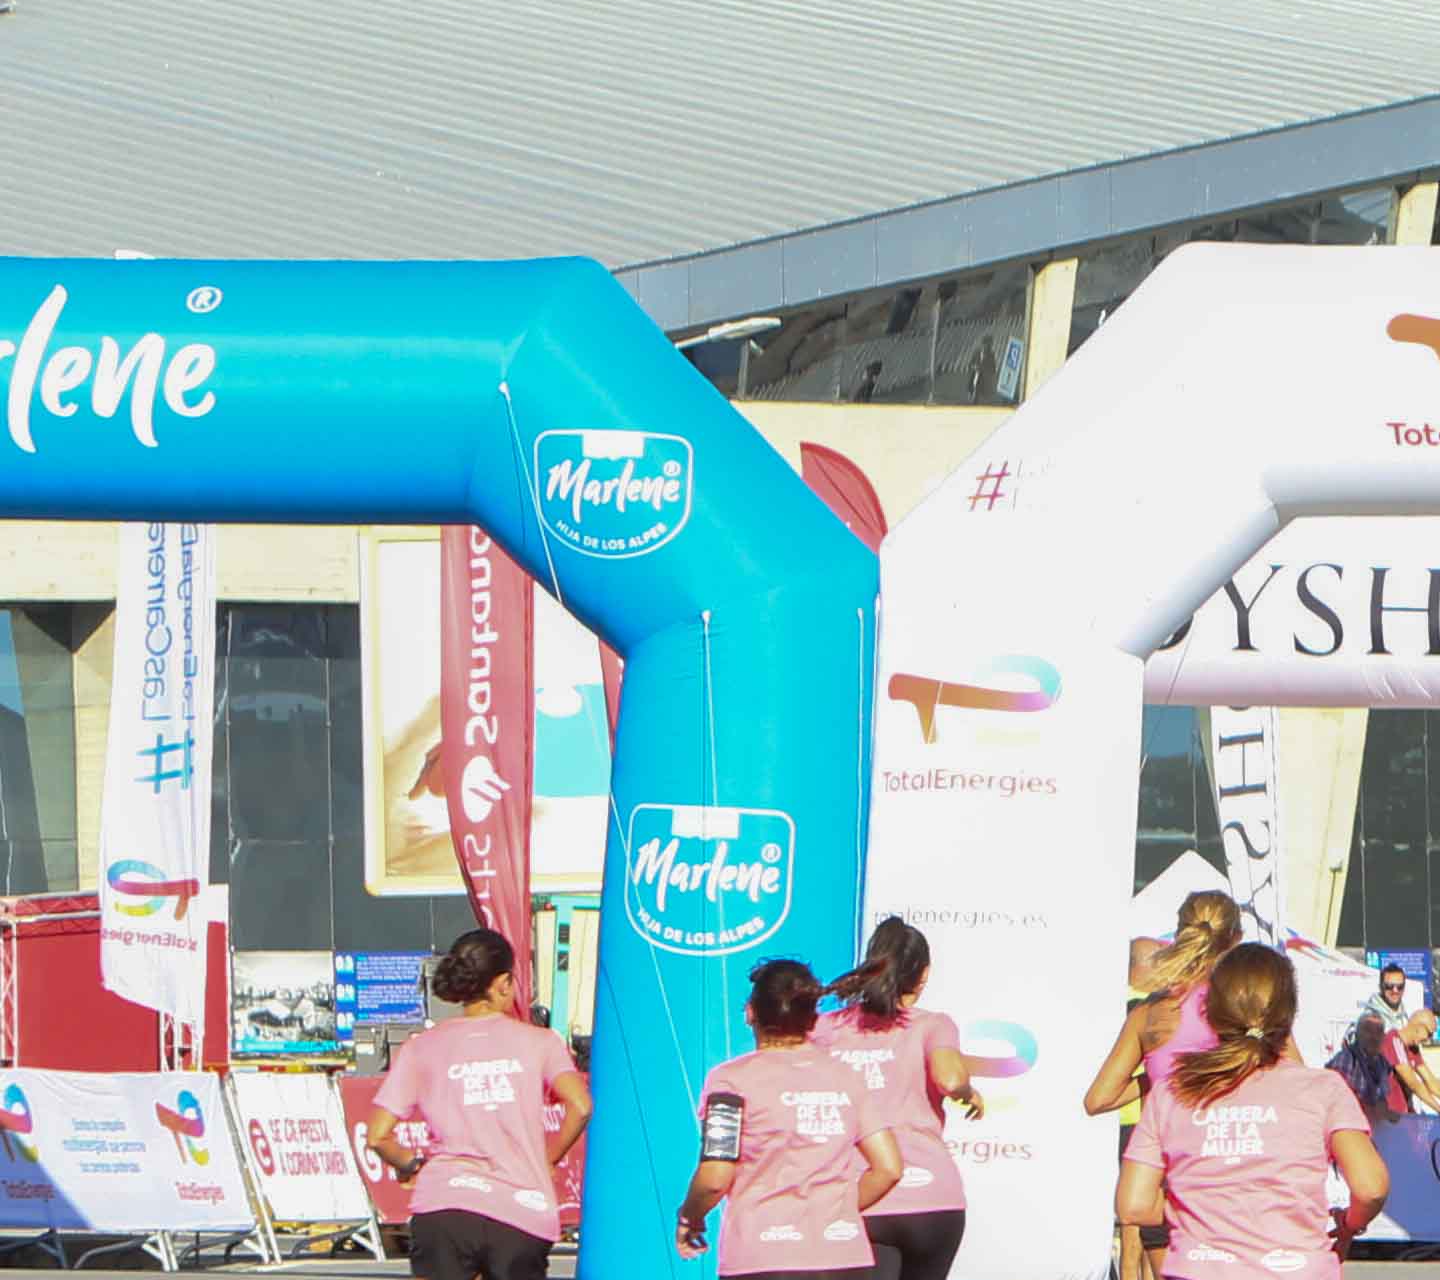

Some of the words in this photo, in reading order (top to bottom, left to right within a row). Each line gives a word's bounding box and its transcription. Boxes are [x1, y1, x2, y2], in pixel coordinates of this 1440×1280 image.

[546, 458, 681, 523] Marlene
[583, 535, 600, 550] DE
[602, 539, 626, 551] LOS
[629, 522, 668, 549] ALPES
[883, 769, 1058, 797] TotalEnergies
[633, 838, 781, 912] Marlene
[664, 927, 682, 943] DE
[685, 932, 715, 945] LOS
[719, 916, 765, 945] ALPES
[448, 1058, 523, 1079] CARRERA
[489, 1074, 512, 1088] LA
[781, 1092, 851, 1106] CARRERA
[797, 1105, 817, 1120] DE
[820, 1105, 841, 1120] LA
[1191, 1105, 1279, 1126] CARRERA
[1206, 1123, 1229, 1139] DE
[1235, 1123, 1260, 1139] LA
